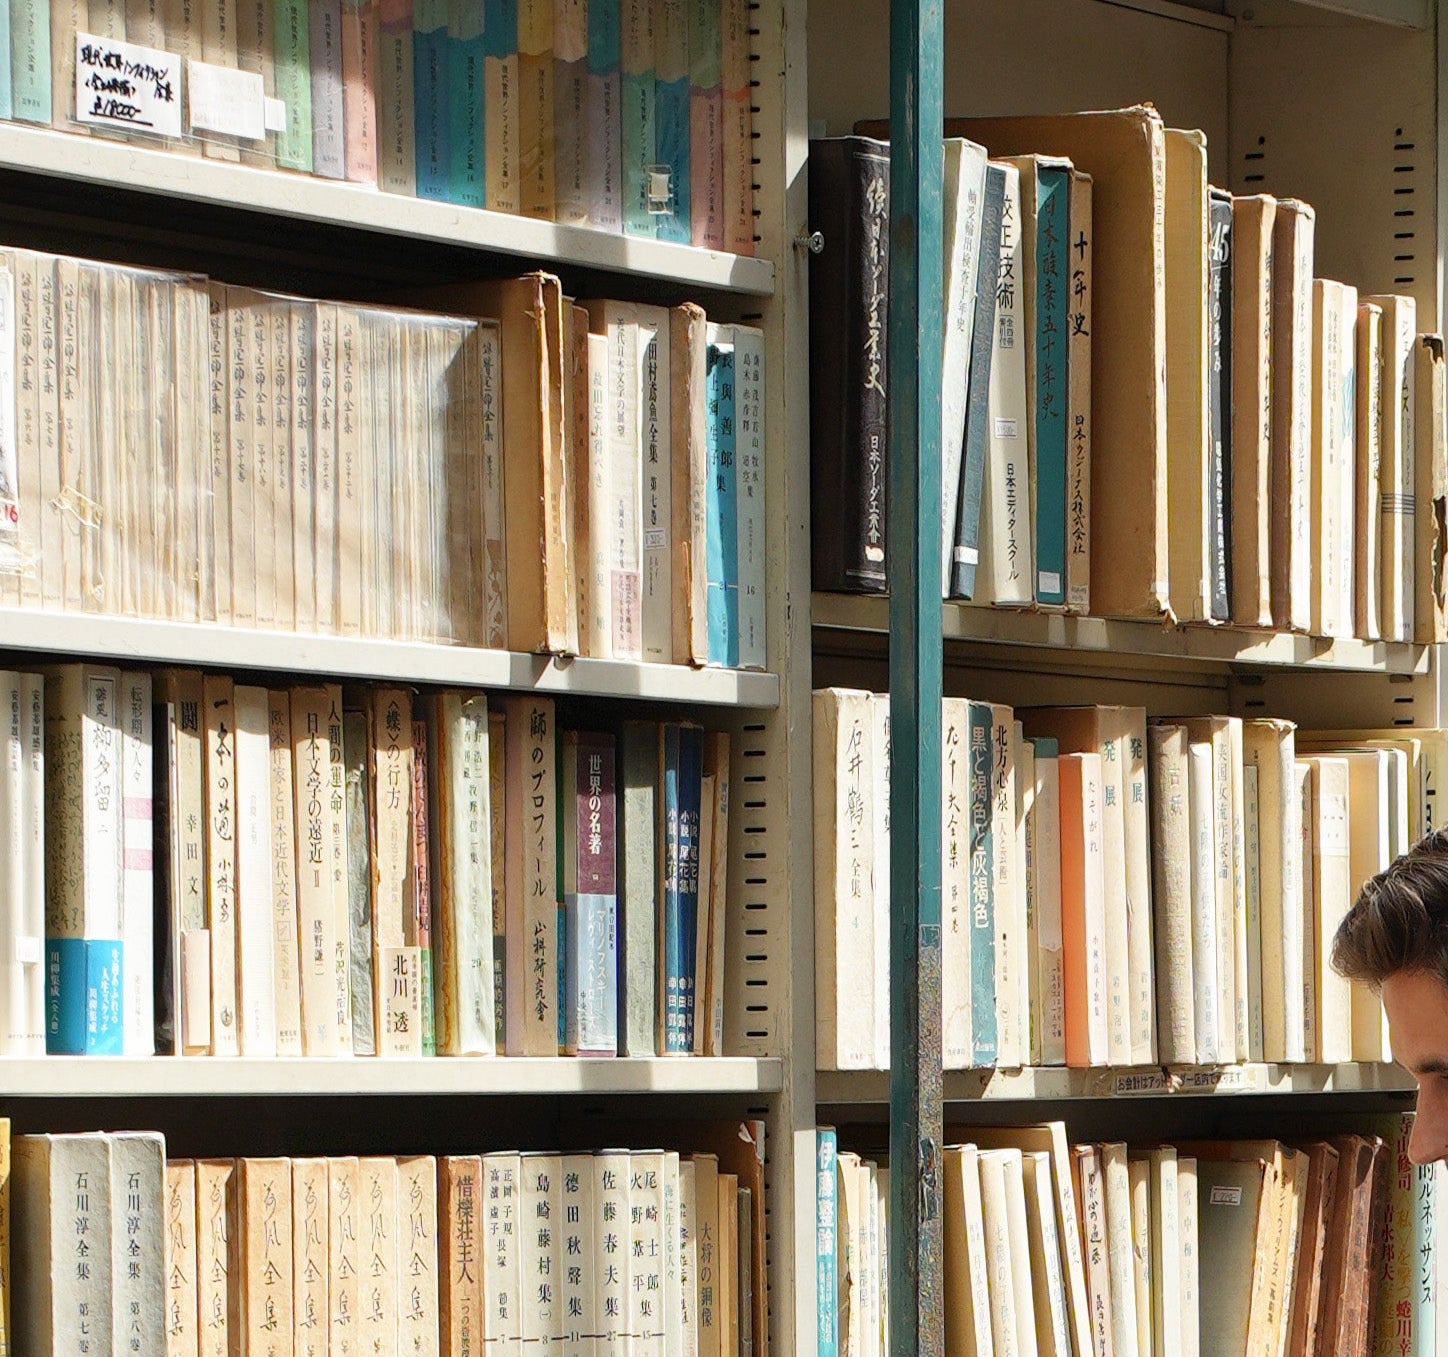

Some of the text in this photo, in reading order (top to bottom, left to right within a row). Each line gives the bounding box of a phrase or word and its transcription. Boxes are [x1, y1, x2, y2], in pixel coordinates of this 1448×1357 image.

[996, 196, 1015, 311] 校正技術
[1071, 232, 1091, 338] 十年史
[306, 713, 324, 864] 日本文学の遠近
[327, 700, 343, 815] 人間の運命
[530, 709, 548, 898] 師のプロフィール
[587, 754, 602, 854] 世界の名著
[185, 813, 199, 895] 幸田文
[971, 725, 990, 929] 黒と褐色と灰褐色
[74, 1171, 90, 1354] 石川淳全集 第七巻
[126, 1171, 141, 1352] 石川淳全集 第八巻
[536, 1173, 552, 1304] 島崎藤村集
[601, 1171, 620, 1319] 佐藤春夫集
[644, 1171, 660, 1291] 尾崎士郎
